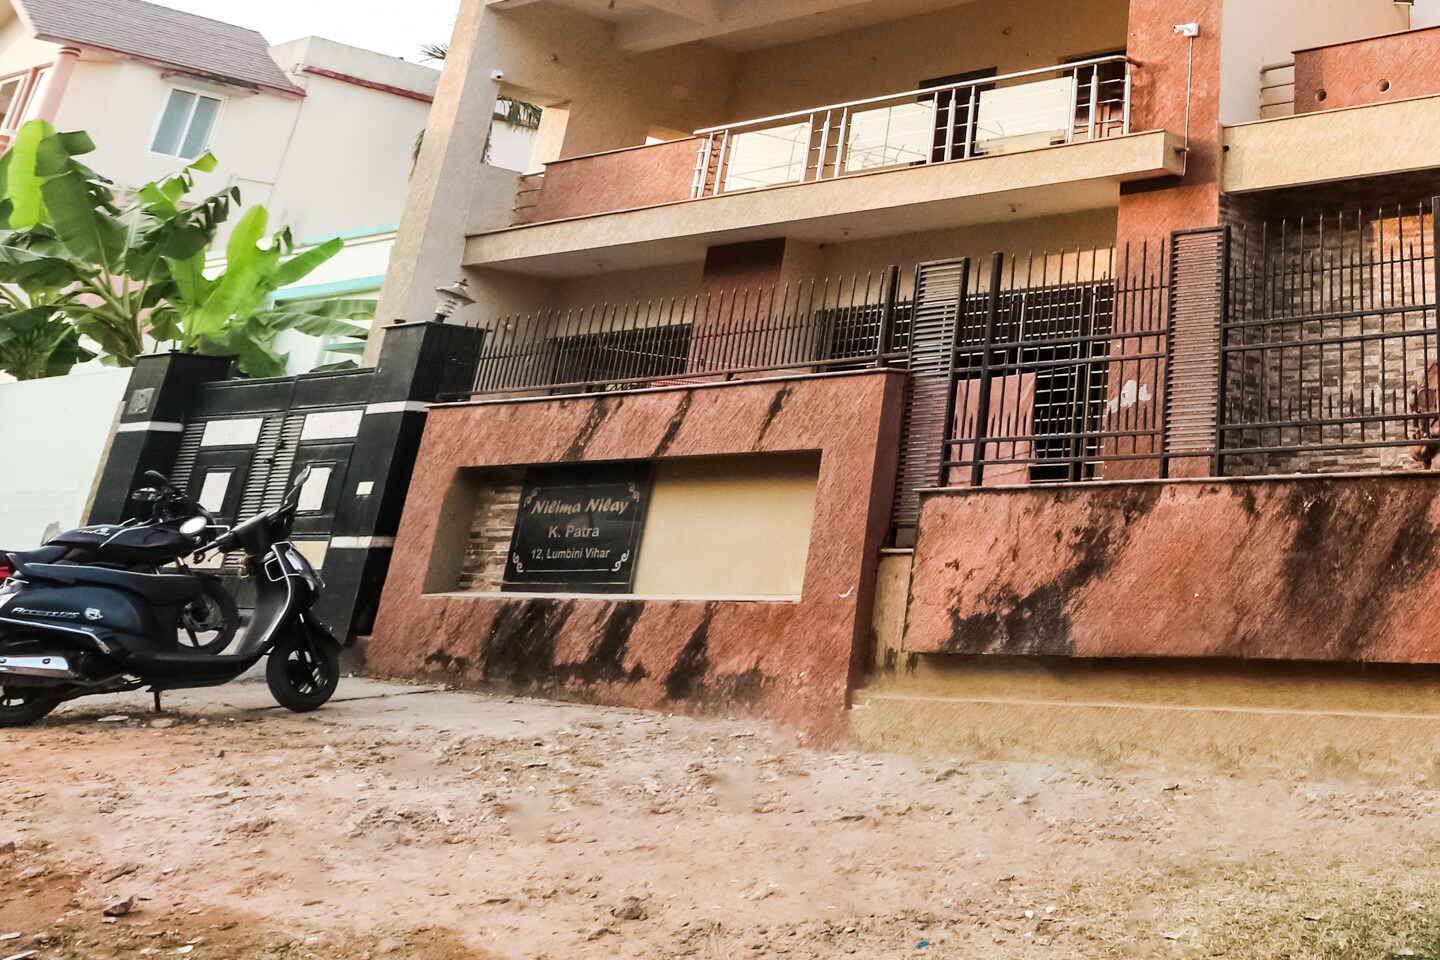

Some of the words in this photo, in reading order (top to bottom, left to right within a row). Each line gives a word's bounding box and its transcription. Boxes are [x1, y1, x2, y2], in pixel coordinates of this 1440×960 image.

[531, 500, 581, 515] Nilima
[584, 498, 629, 515] Nilay
[548, 526, 561, 538] K.
[565, 525, 600, 538] Patra
[531, 548, 544, 560] 12,
[546, 548, 583, 559] Lumbini
[585, 547, 610, 559] Vihar
